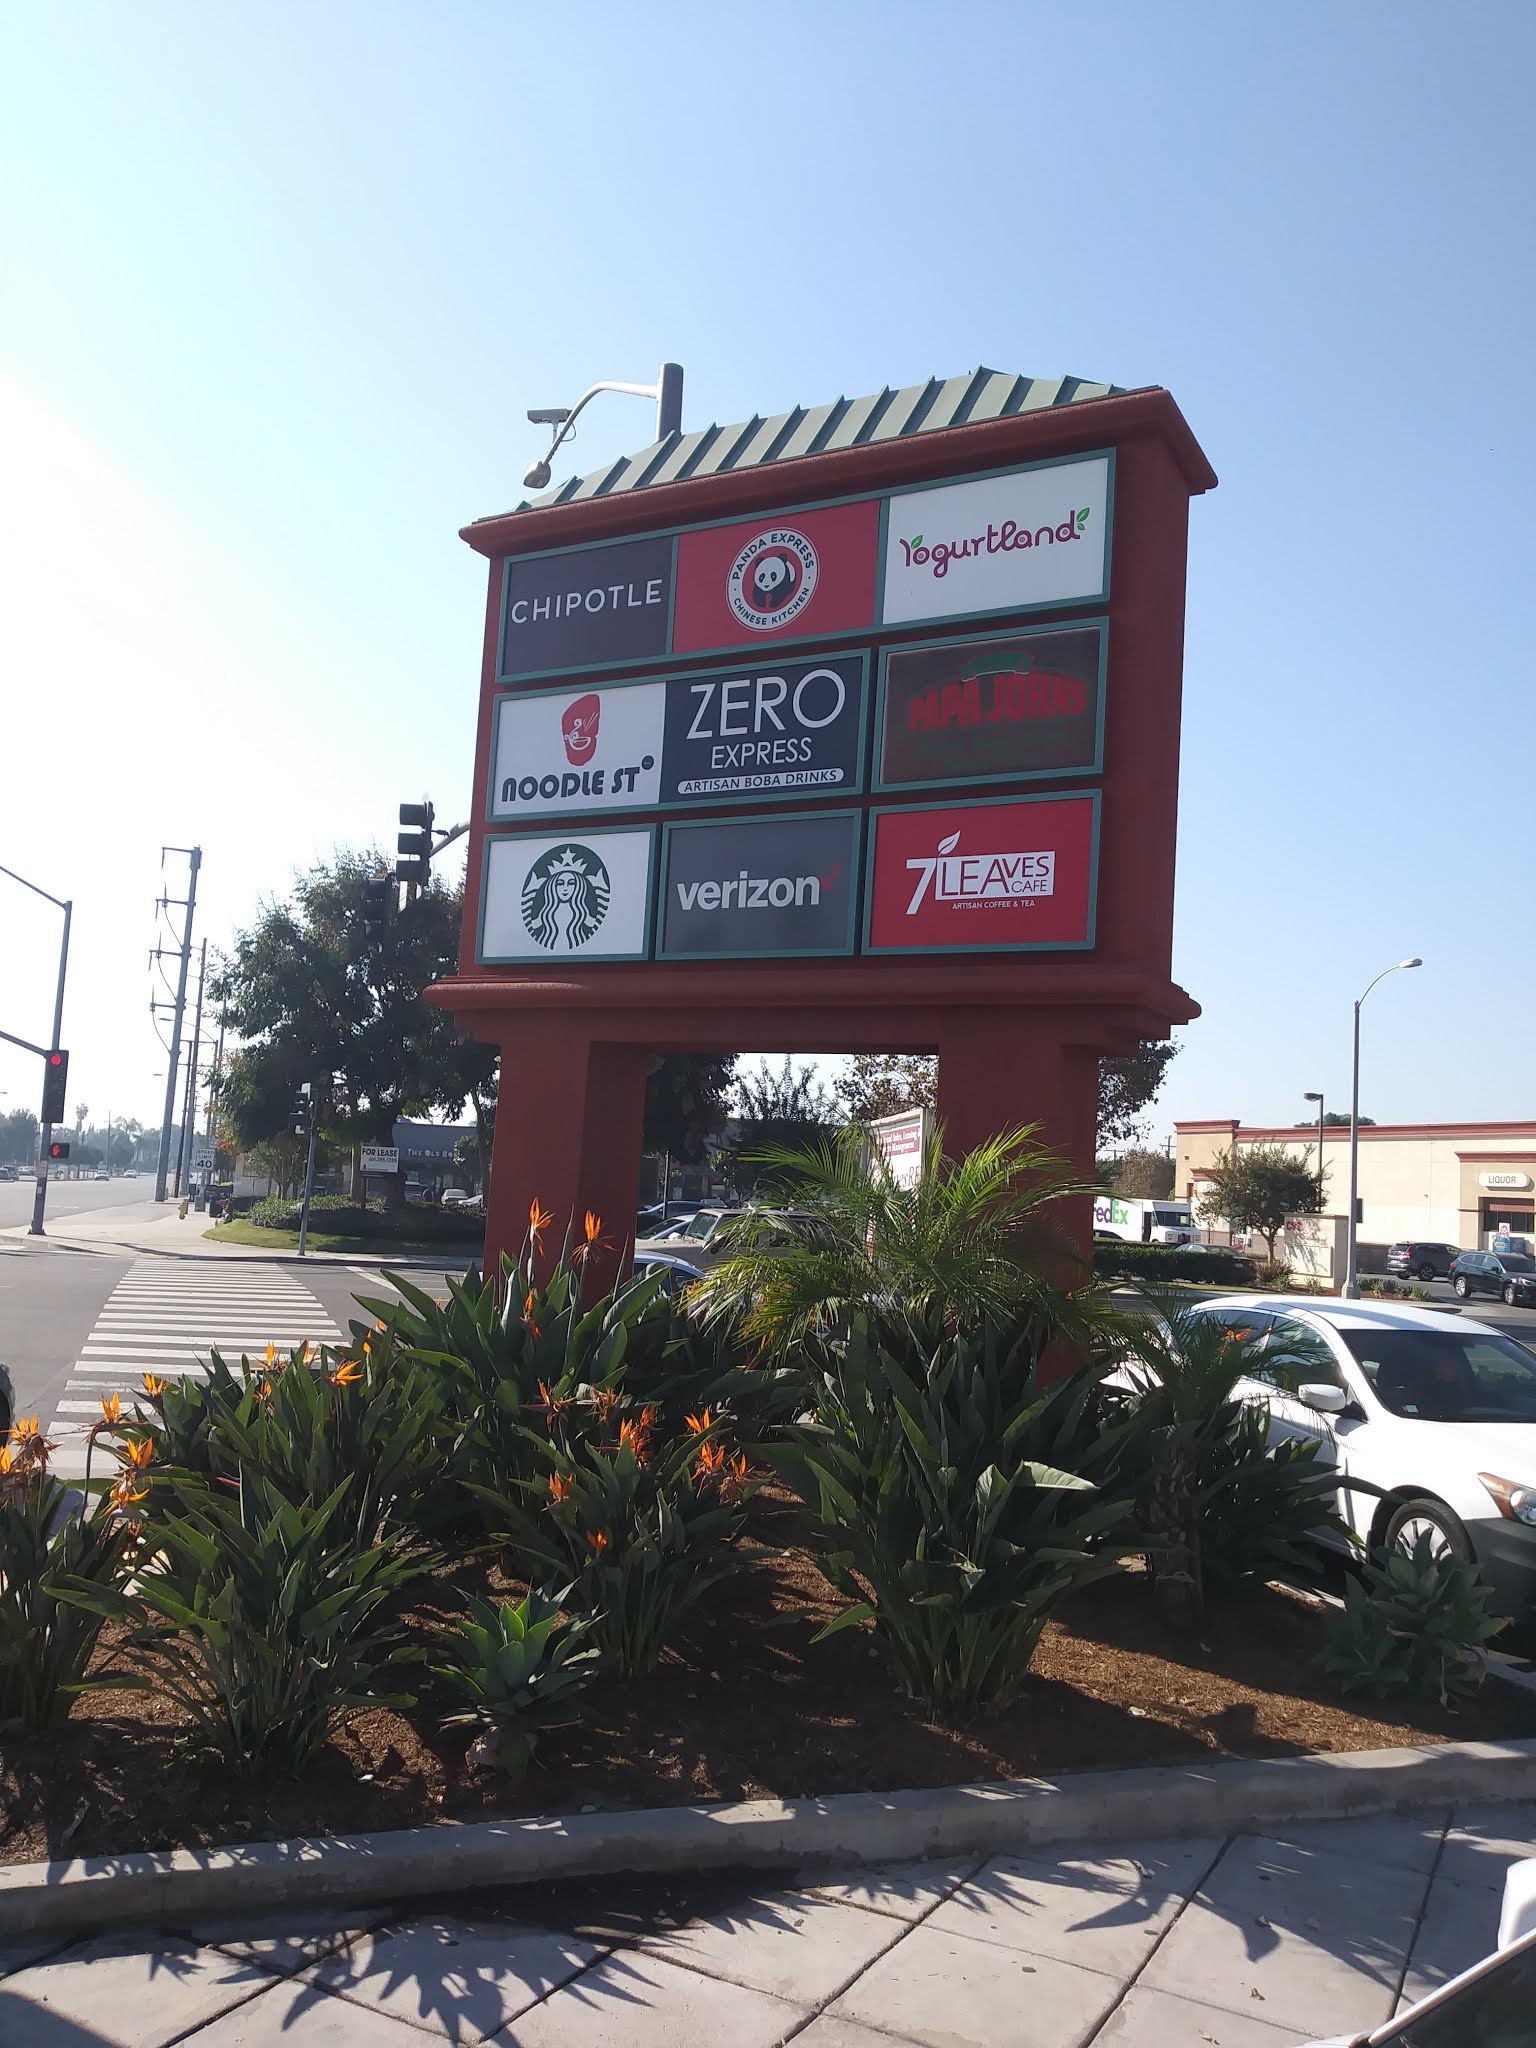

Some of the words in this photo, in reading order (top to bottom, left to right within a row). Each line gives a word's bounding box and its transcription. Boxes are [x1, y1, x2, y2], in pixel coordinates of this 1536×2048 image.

[732, 538, 767, 580] PANDA
[770, 532, 814, 569] EXPRESS
[899, 509, 1081, 578] Yogurtland
[511, 578, 663, 624] CHIPOTLE
[733, 597, 768, 626] CHINESE
[771, 587, 810, 625] KITCHEN
[685, 668, 846, 741] ZERO
[909, 678, 982, 730] PAPA
[711, 736, 813, 770] EXPRESS
[501, 768, 605, 802] NOODLE
[611, 765, 641, 794] ST
[683, 775, 742, 794] ARTISAN
[744, 771, 782, 788] BOBA
[784, 768, 838, 785] DRINKS
[676, 870, 821, 911] verizon
[941, 855, 1050, 897] LEAVES
[1011, 878, 1048, 894] CAFE
[952, 901, 983, 910] ARTISAN
[984, 900, 1011, 909] COFFEE
[1012, 900, 1018, 908] &
[1020, 899, 1035, 908] TEA
[197, 1160, 212, 1168] 40
[362, 1148, 376, 1156] FOR
[377, 1148, 398, 1158] LEASE
[1488, 1175, 1517, 1184] LIQUOR
[1093, 1198, 1129, 1225] edEx
